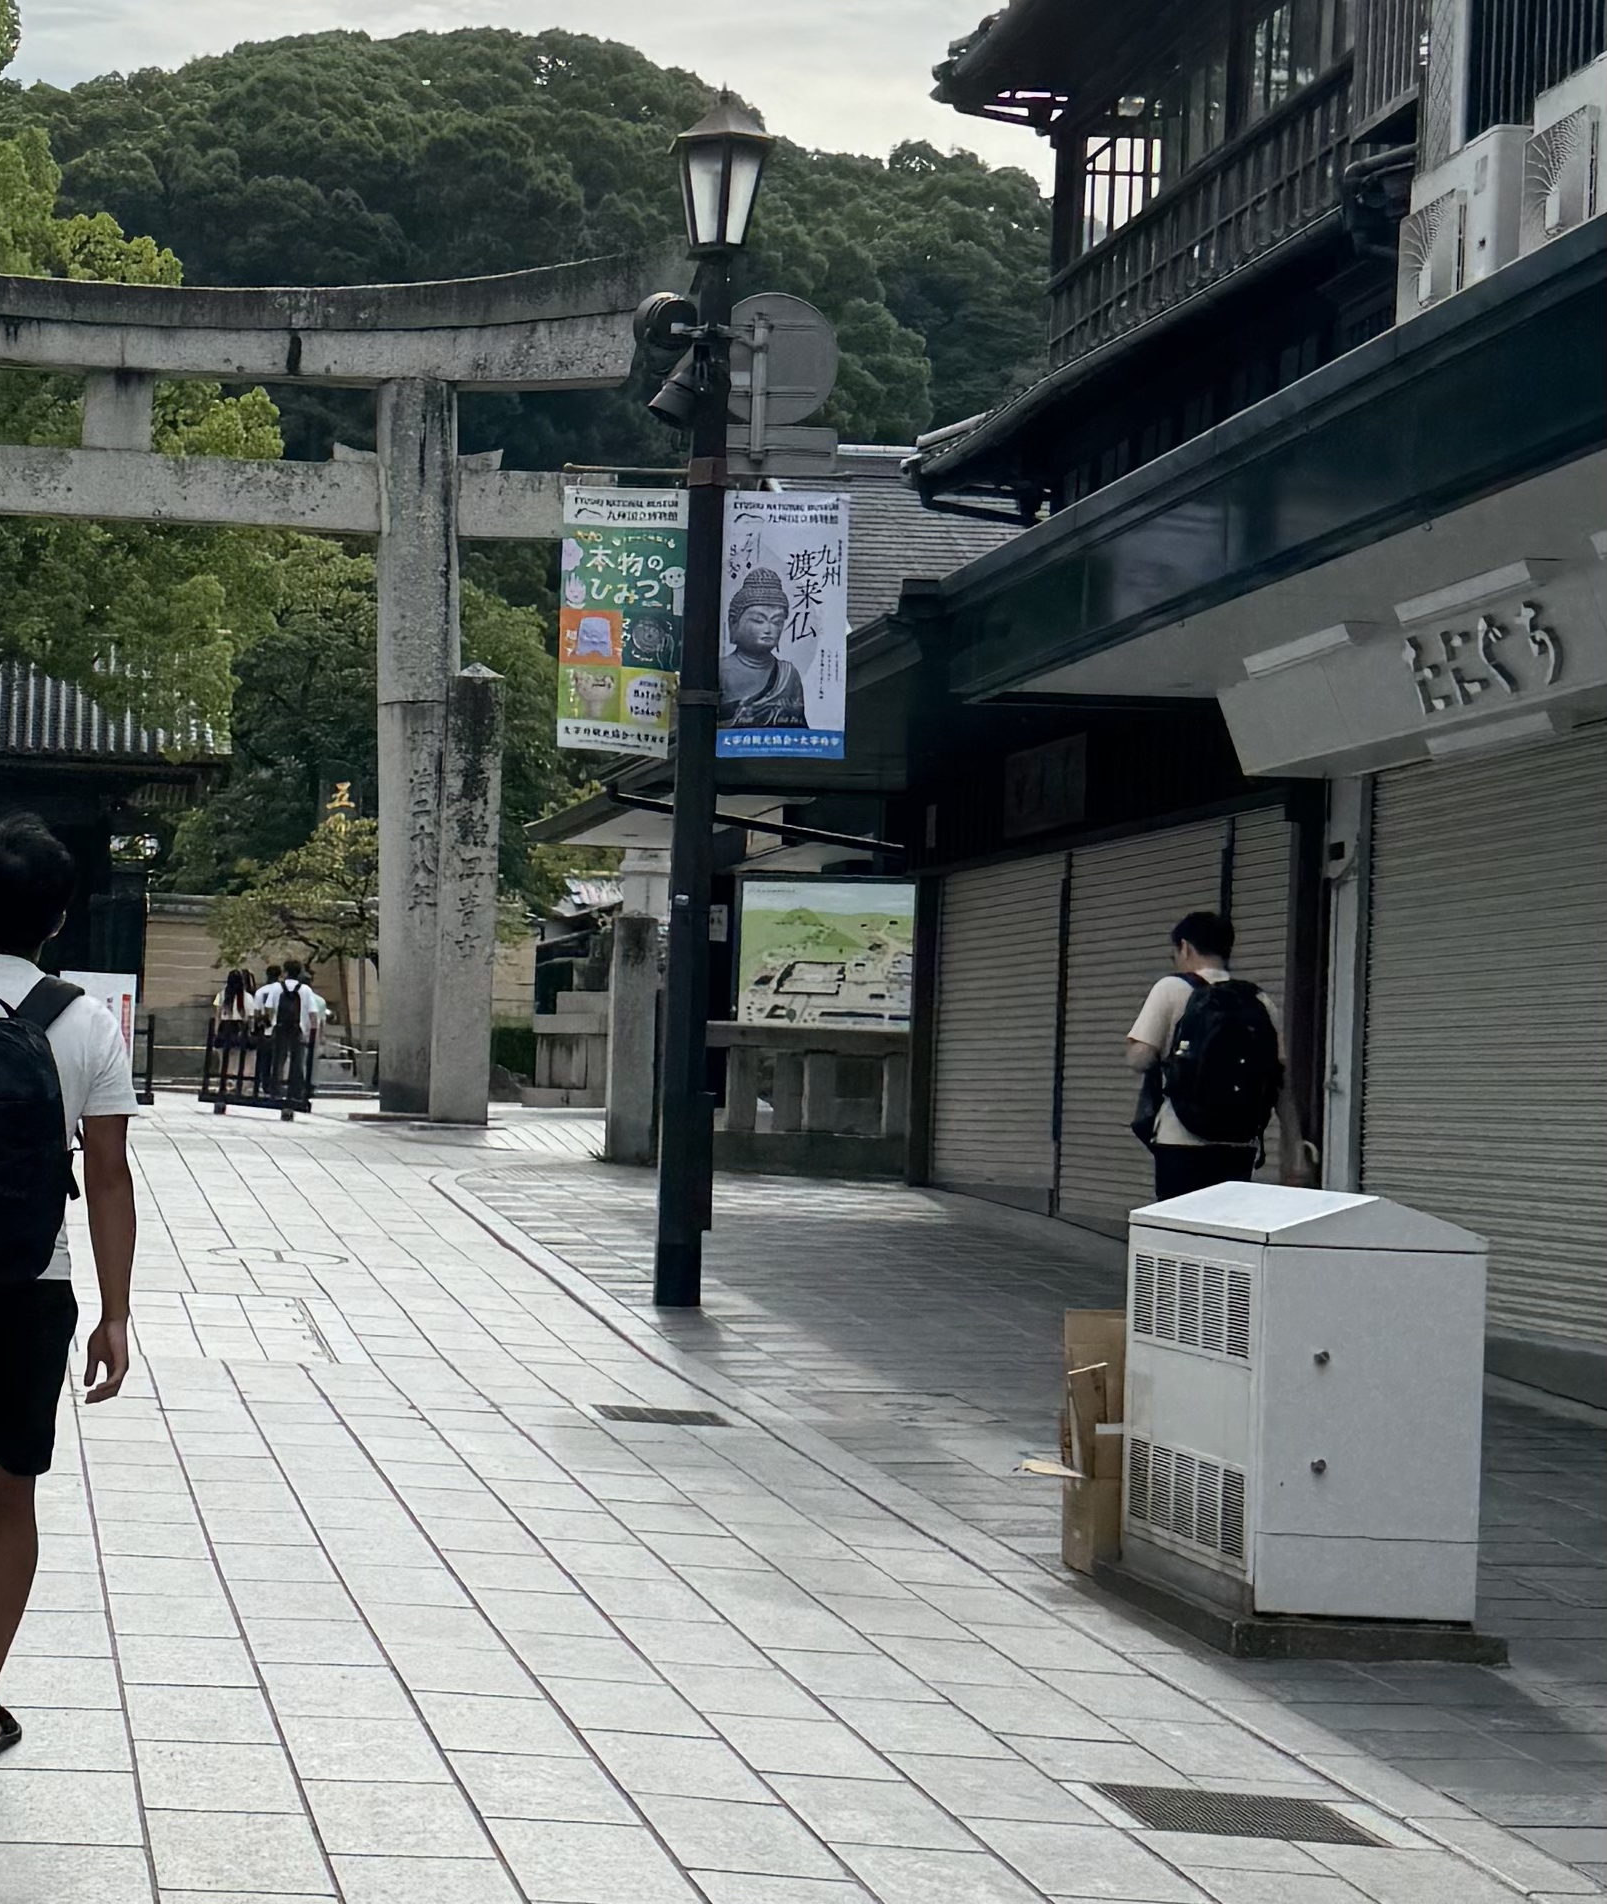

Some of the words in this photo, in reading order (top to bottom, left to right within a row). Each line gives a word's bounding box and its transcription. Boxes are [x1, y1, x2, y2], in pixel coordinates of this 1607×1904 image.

[585, 544, 664, 577] 本物の
[590, 578, 661, 605] ひみつ
[784, 549, 824, 643] 渡来仏
